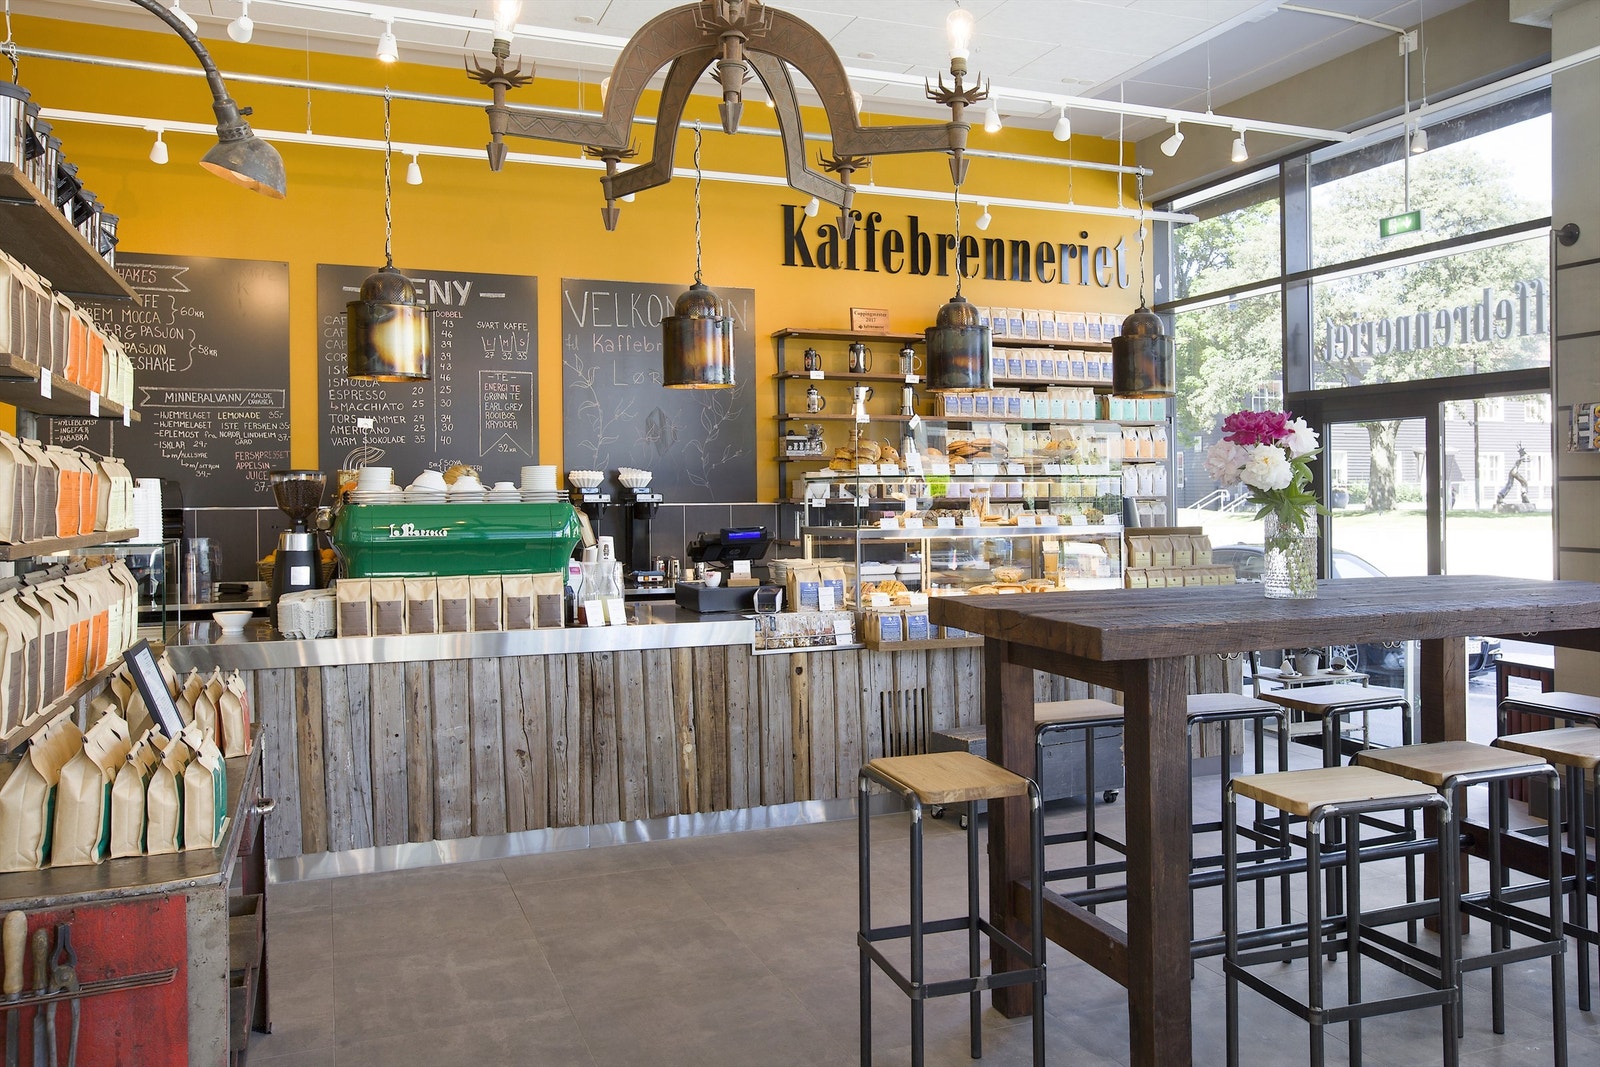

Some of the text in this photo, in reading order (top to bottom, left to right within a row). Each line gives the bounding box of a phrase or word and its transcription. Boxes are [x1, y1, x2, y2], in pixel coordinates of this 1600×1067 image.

[781, 203, 1131, 290] Kaffebrenneriet
[115, 268, 157, 284] HAKES
[410, 277, 473, 306] ENY
[121, 308, 161, 324] MOCCA
[435, 311, 464, 319] DOBBEL
[564, 289, 748, 332] VELKON
[323, 315, 454, 329] CAF 43
[476, 321, 529, 332] SVART KAFFE
[124, 324, 137, 340] &
[140, 325, 185, 340] PASJON
[323, 327, 453, 339] CAF 46
[124, 342, 167, 355] PASJON
[325, 340, 452, 350] CAP 39
[592, 334, 662, 354] Kaffebr
[324, 352, 452, 362] COR 39
[484, 351, 528, 361] 27 32 35
[129, 356, 177, 373] ESHAKE
[327, 364, 349, 375] ISK
[440, 373, 452, 382] 46
[612, 359, 663, 386] LØR
[328, 385, 452, 401] ESPRESSO 20 25
[484, 382, 521, 393] ENERGI TE
[510, 392, 520, 401] TE
[340, 398, 453, 412] MACCHIATO 25 30
[484, 402, 524, 412] EARL GREY
[217, 411, 261, 420] LEMONADE
[328, 413, 357, 424] TORS
[413, 414, 425, 422] 29
[440, 414, 452, 423] 34
[221, 422, 239, 430] ISTE
[243, 422, 278, 431] FERSKEN
[330, 423, 454, 435] AMERICANO 25 30
[331, 436, 358, 446] VARM
[414, 435, 426, 444] 35
[440, 436, 452, 445] 40
[245, 470, 270, 481] JUICE
[400, 522, 448, 537] Marzocco
